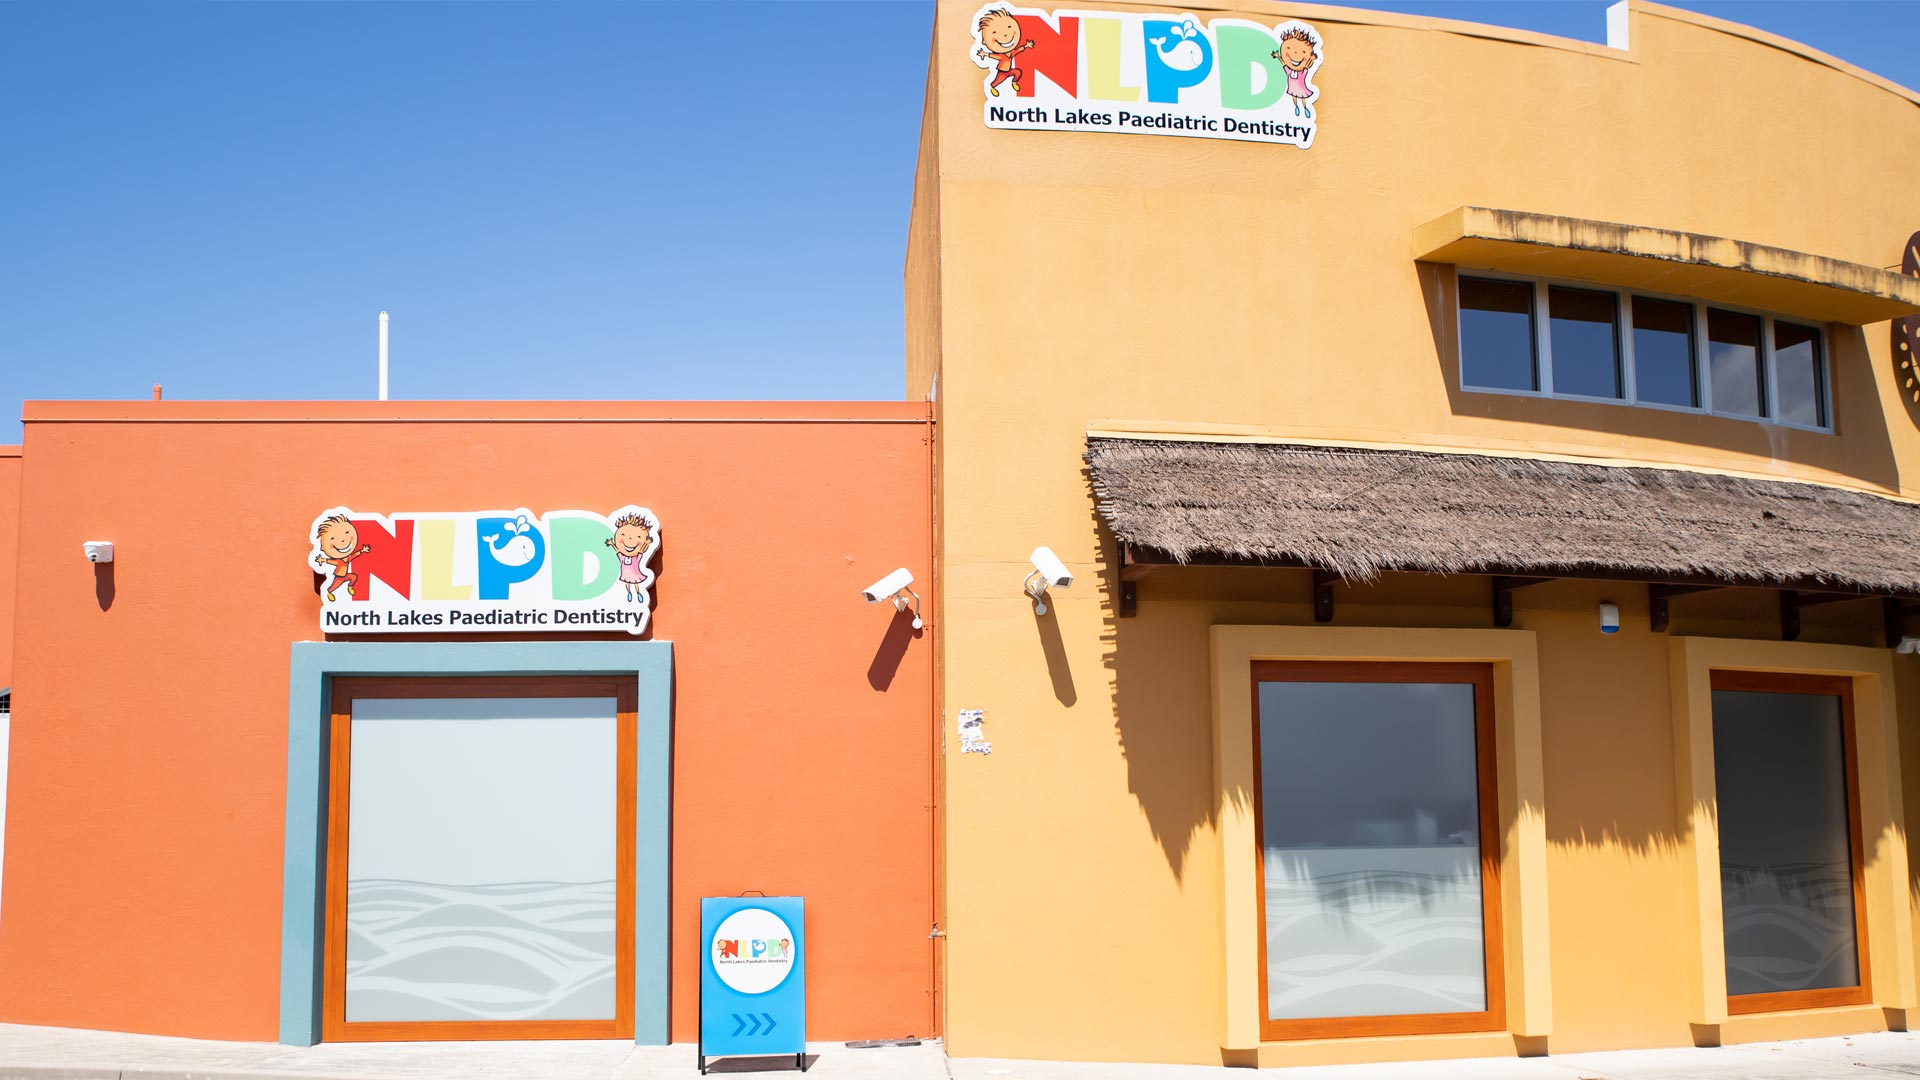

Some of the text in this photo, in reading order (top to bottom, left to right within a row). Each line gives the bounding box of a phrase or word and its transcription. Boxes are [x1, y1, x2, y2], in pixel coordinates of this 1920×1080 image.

[990, 106, 1311, 142] North Lakes Paediatric Dentistry
[326, 609, 643, 628] North Lakes Paediatric Dentistry
